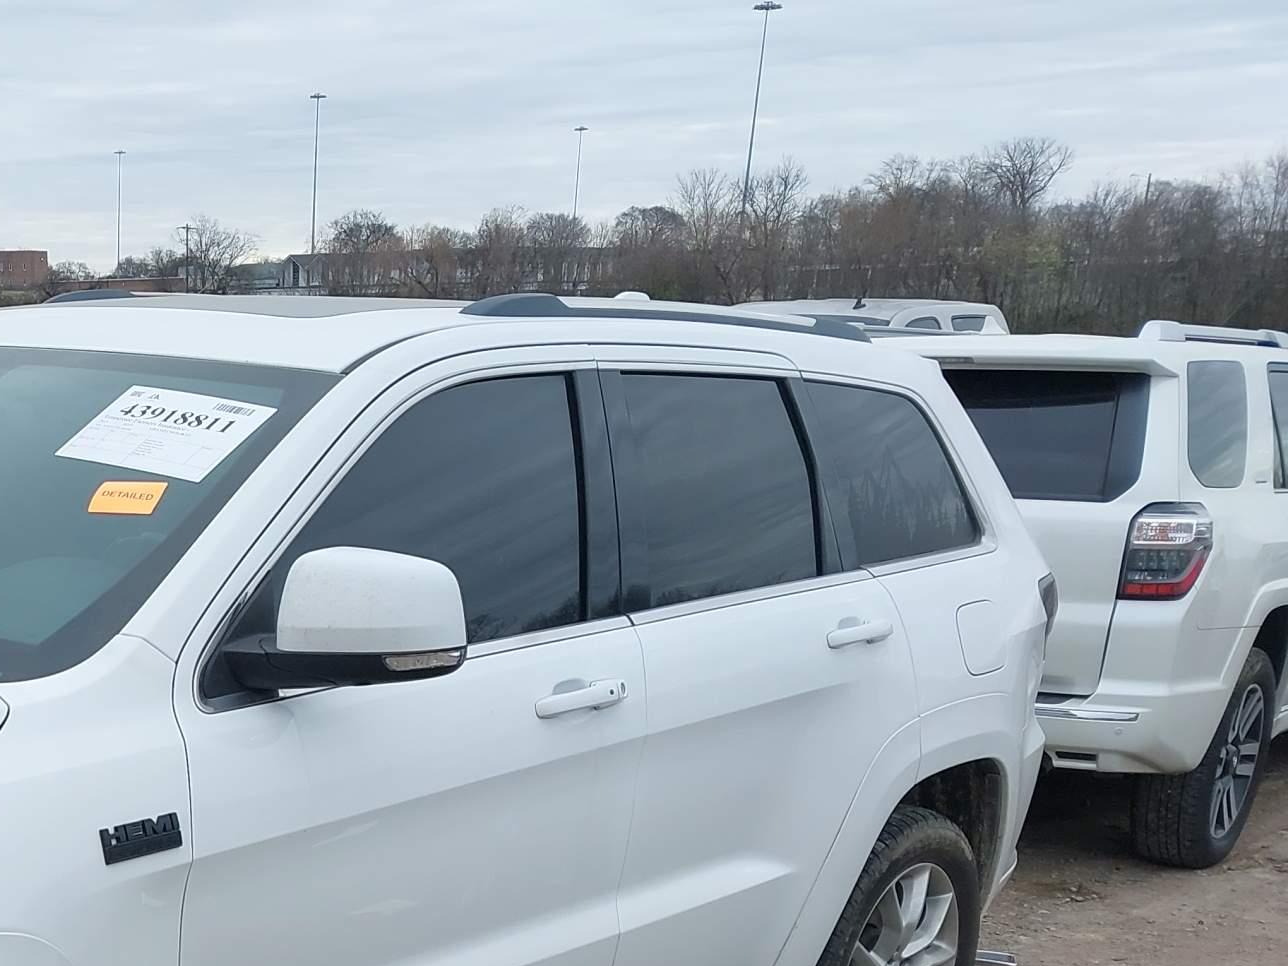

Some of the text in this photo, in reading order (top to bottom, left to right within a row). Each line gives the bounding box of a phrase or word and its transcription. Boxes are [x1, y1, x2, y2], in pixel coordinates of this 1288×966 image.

[120, 403, 236, 433] 43918811
[102, 489, 154, 502] DETAILED
[99, 812, 181, 850] HEMI
